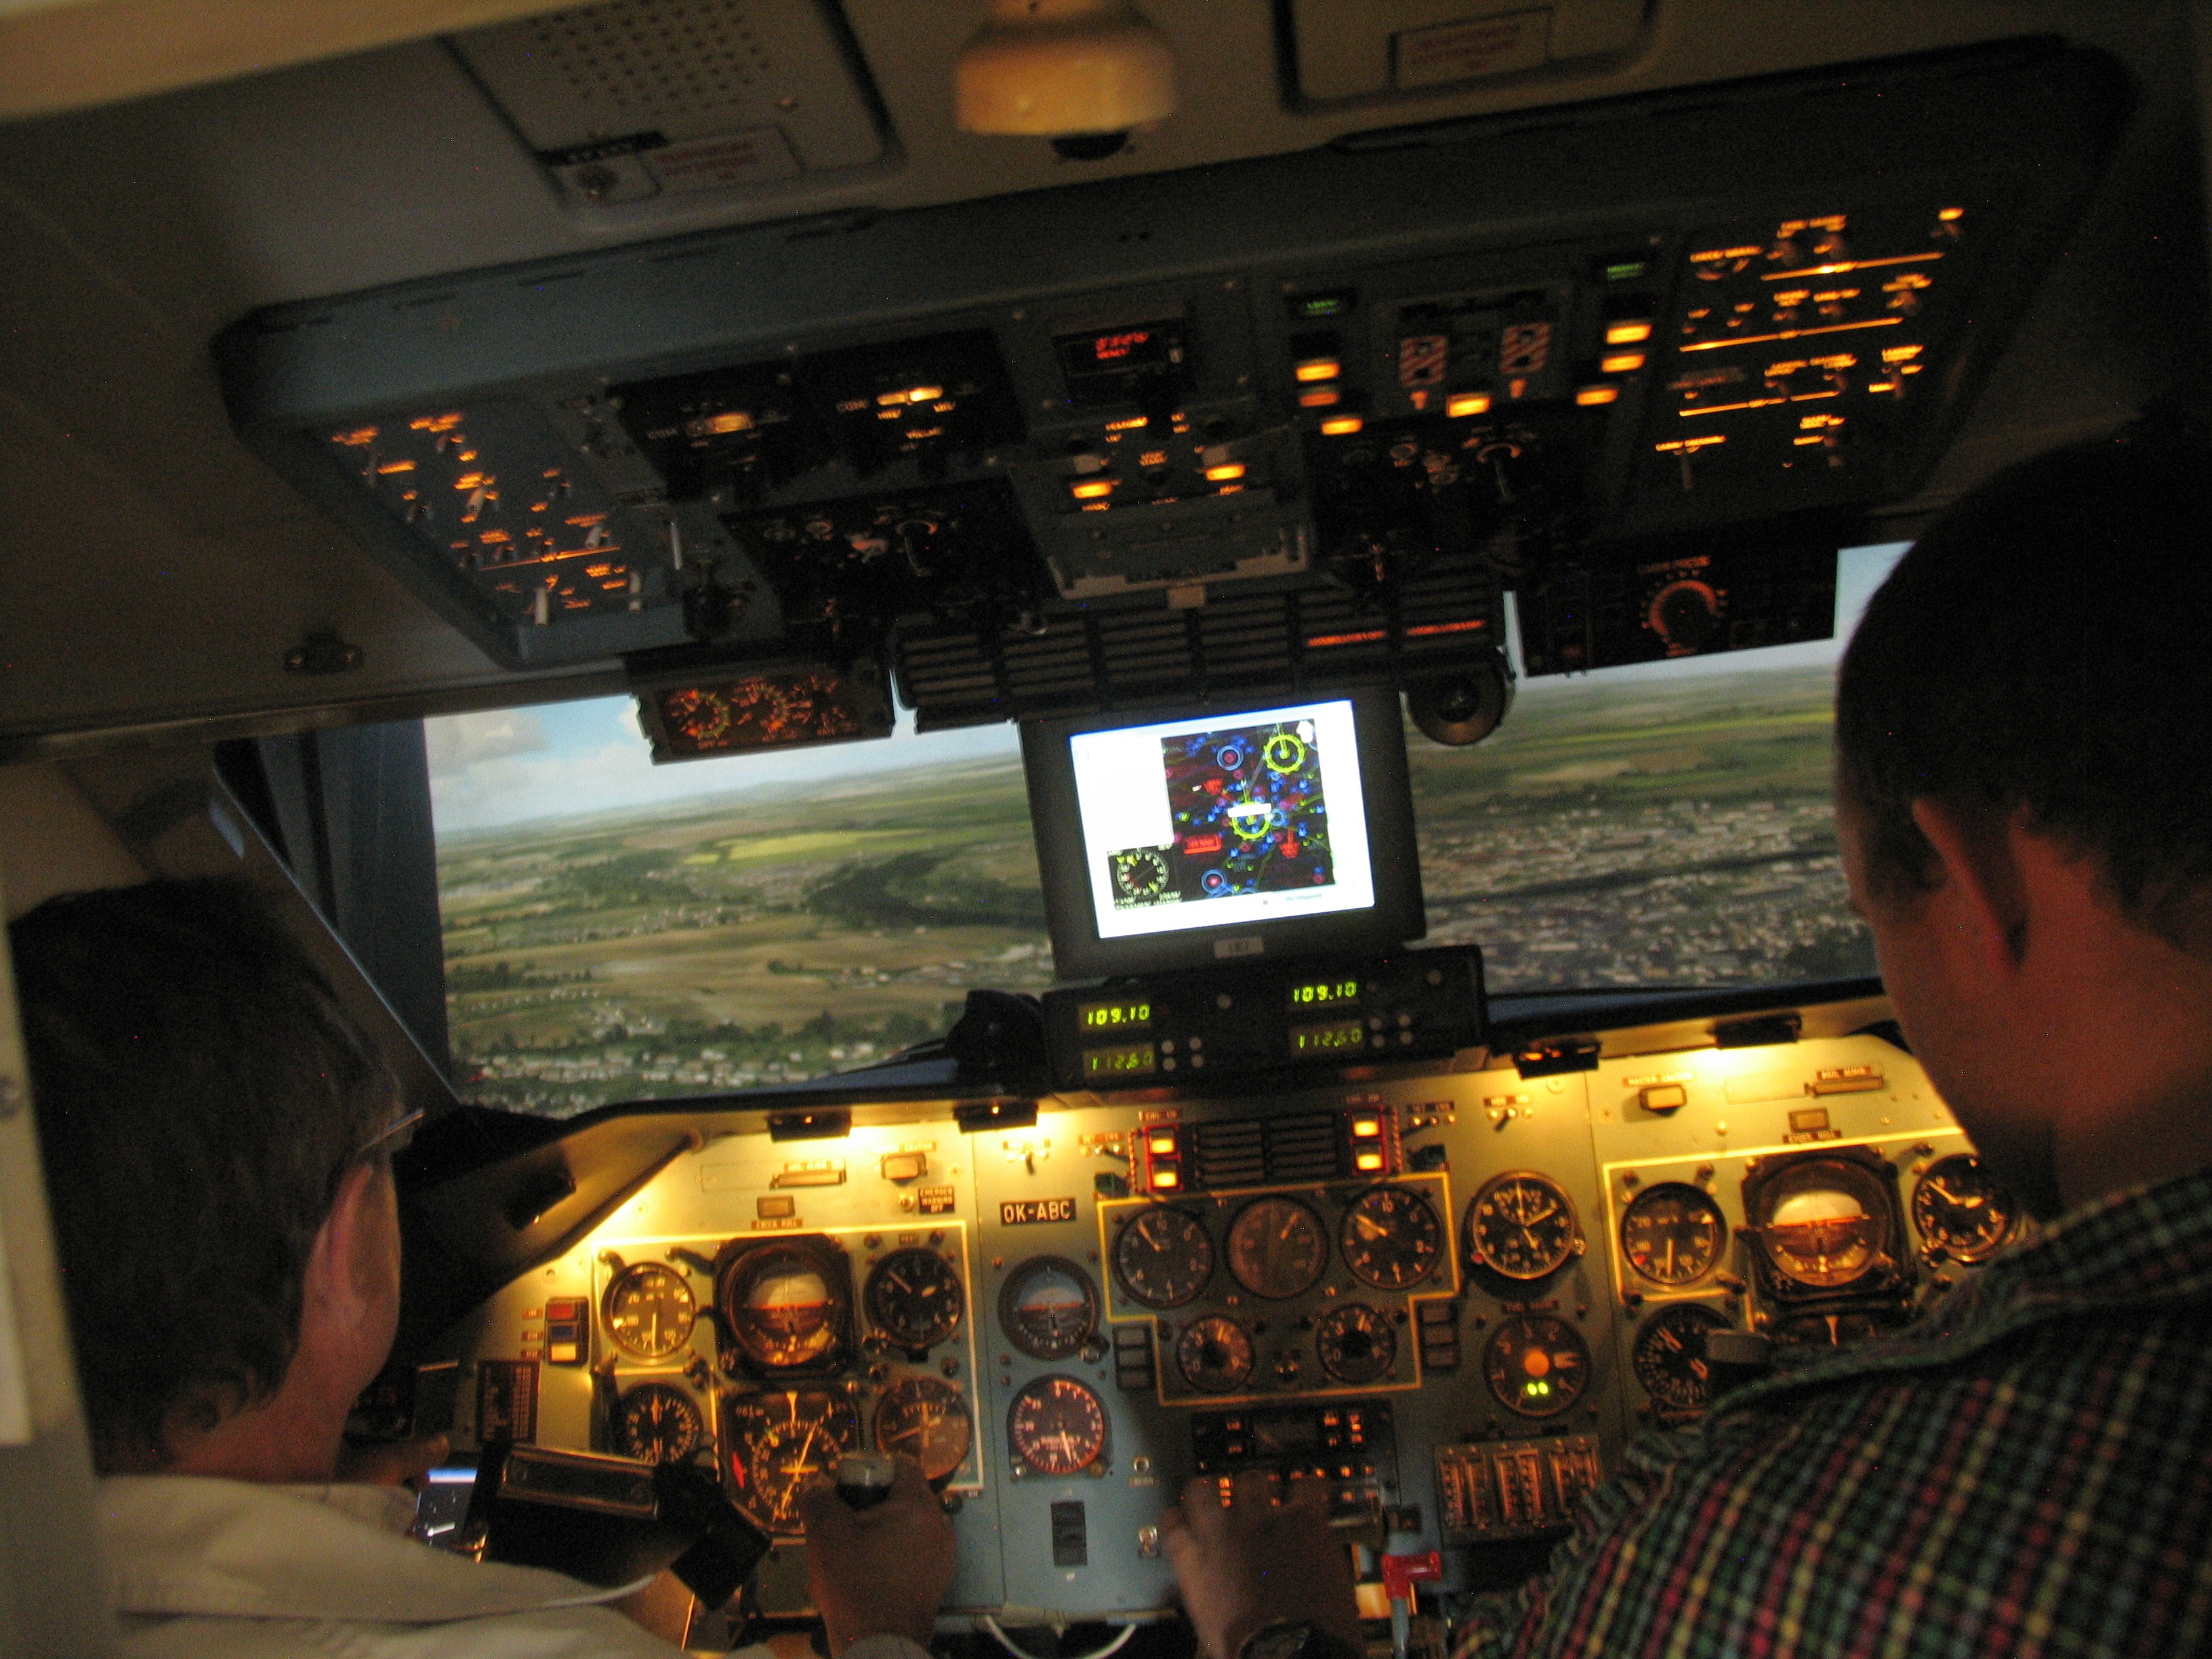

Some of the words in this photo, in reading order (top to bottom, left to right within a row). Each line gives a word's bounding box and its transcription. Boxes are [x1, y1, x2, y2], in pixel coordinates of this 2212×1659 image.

[1294, 981, 1357, 1003] 109.10
[1088, 1004, 1151, 1025] 109.10
[1004, 1201, 1072, 1224] OK-ABC
